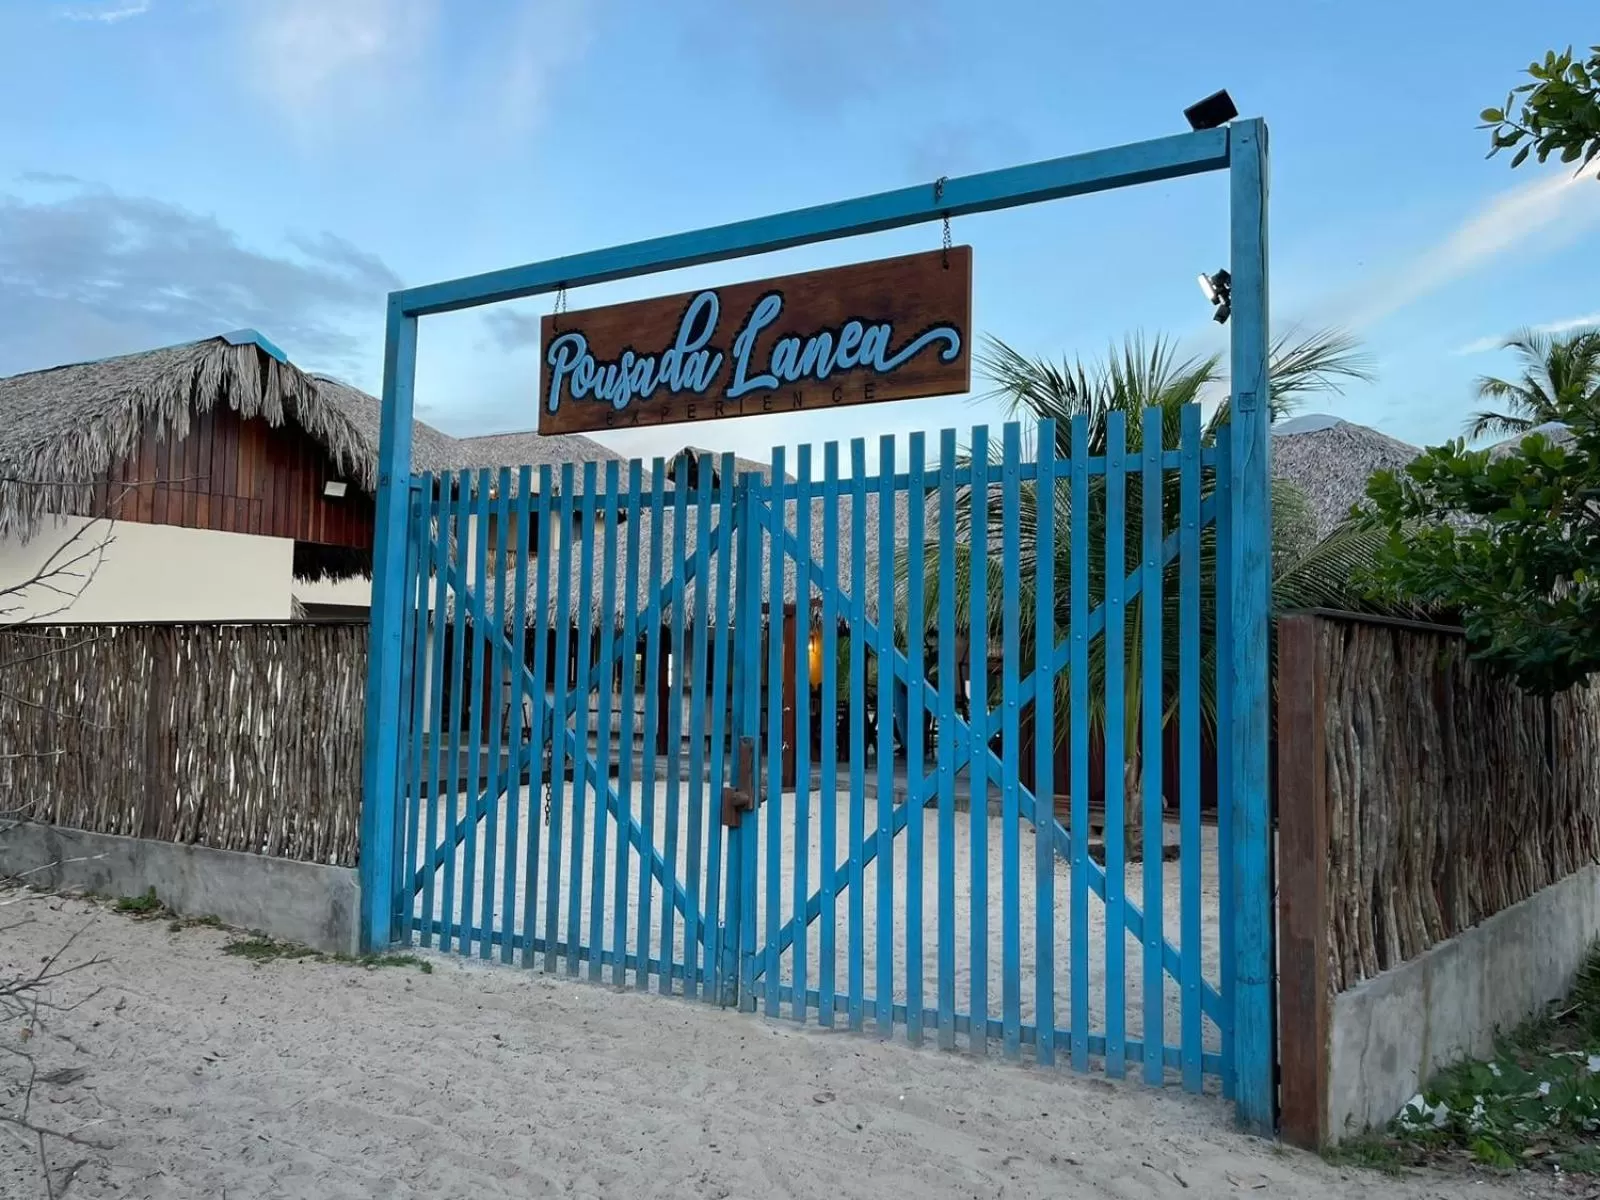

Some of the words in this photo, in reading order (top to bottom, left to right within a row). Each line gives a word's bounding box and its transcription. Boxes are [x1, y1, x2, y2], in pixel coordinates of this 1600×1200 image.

[547, 290, 723, 413] Pousada
[726, 294, 961, 398] Lanea
[606, 383, 876, 426] EXPERIENCE
